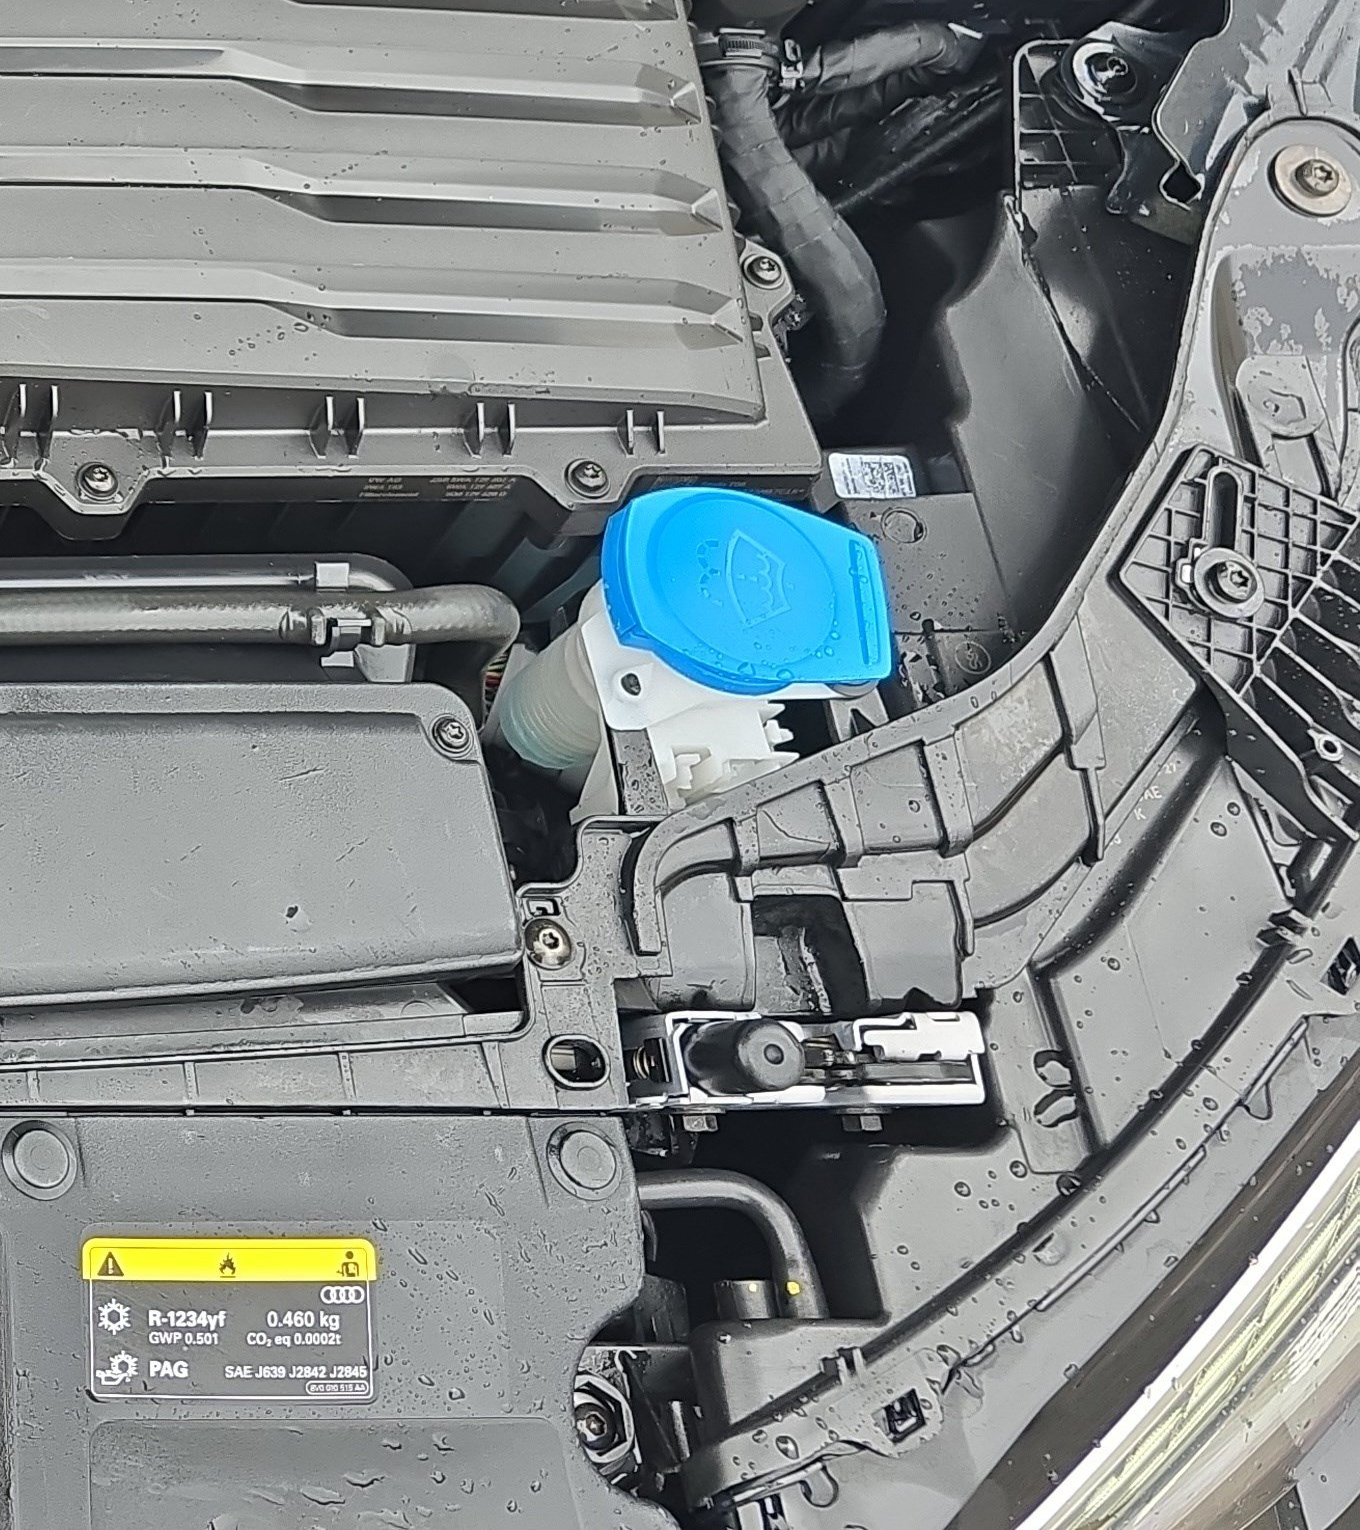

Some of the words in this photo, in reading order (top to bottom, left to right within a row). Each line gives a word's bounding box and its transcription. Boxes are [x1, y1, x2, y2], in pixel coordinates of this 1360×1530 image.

[147, 1309, 227, 1331] R-1234yf
[266, 1310, 314, 1328] 0.460
[319, 1309, 340, 1331] kg
[148, 1331, 182, 1345] GWP
[184, 1332, 219, 1345] 0.501
[274, 1334, 291, 1348] eq
[293, 1331, 342, 1346] 0.0002t
[148, 1360, 189, 1378] PAG
[224, 1366, 253, 1379] SAE
[255, 1366, 286, 1379] J639
[288, 1366, 327, 1379] J2842
[329, 1365, 368, 1379] J2845
